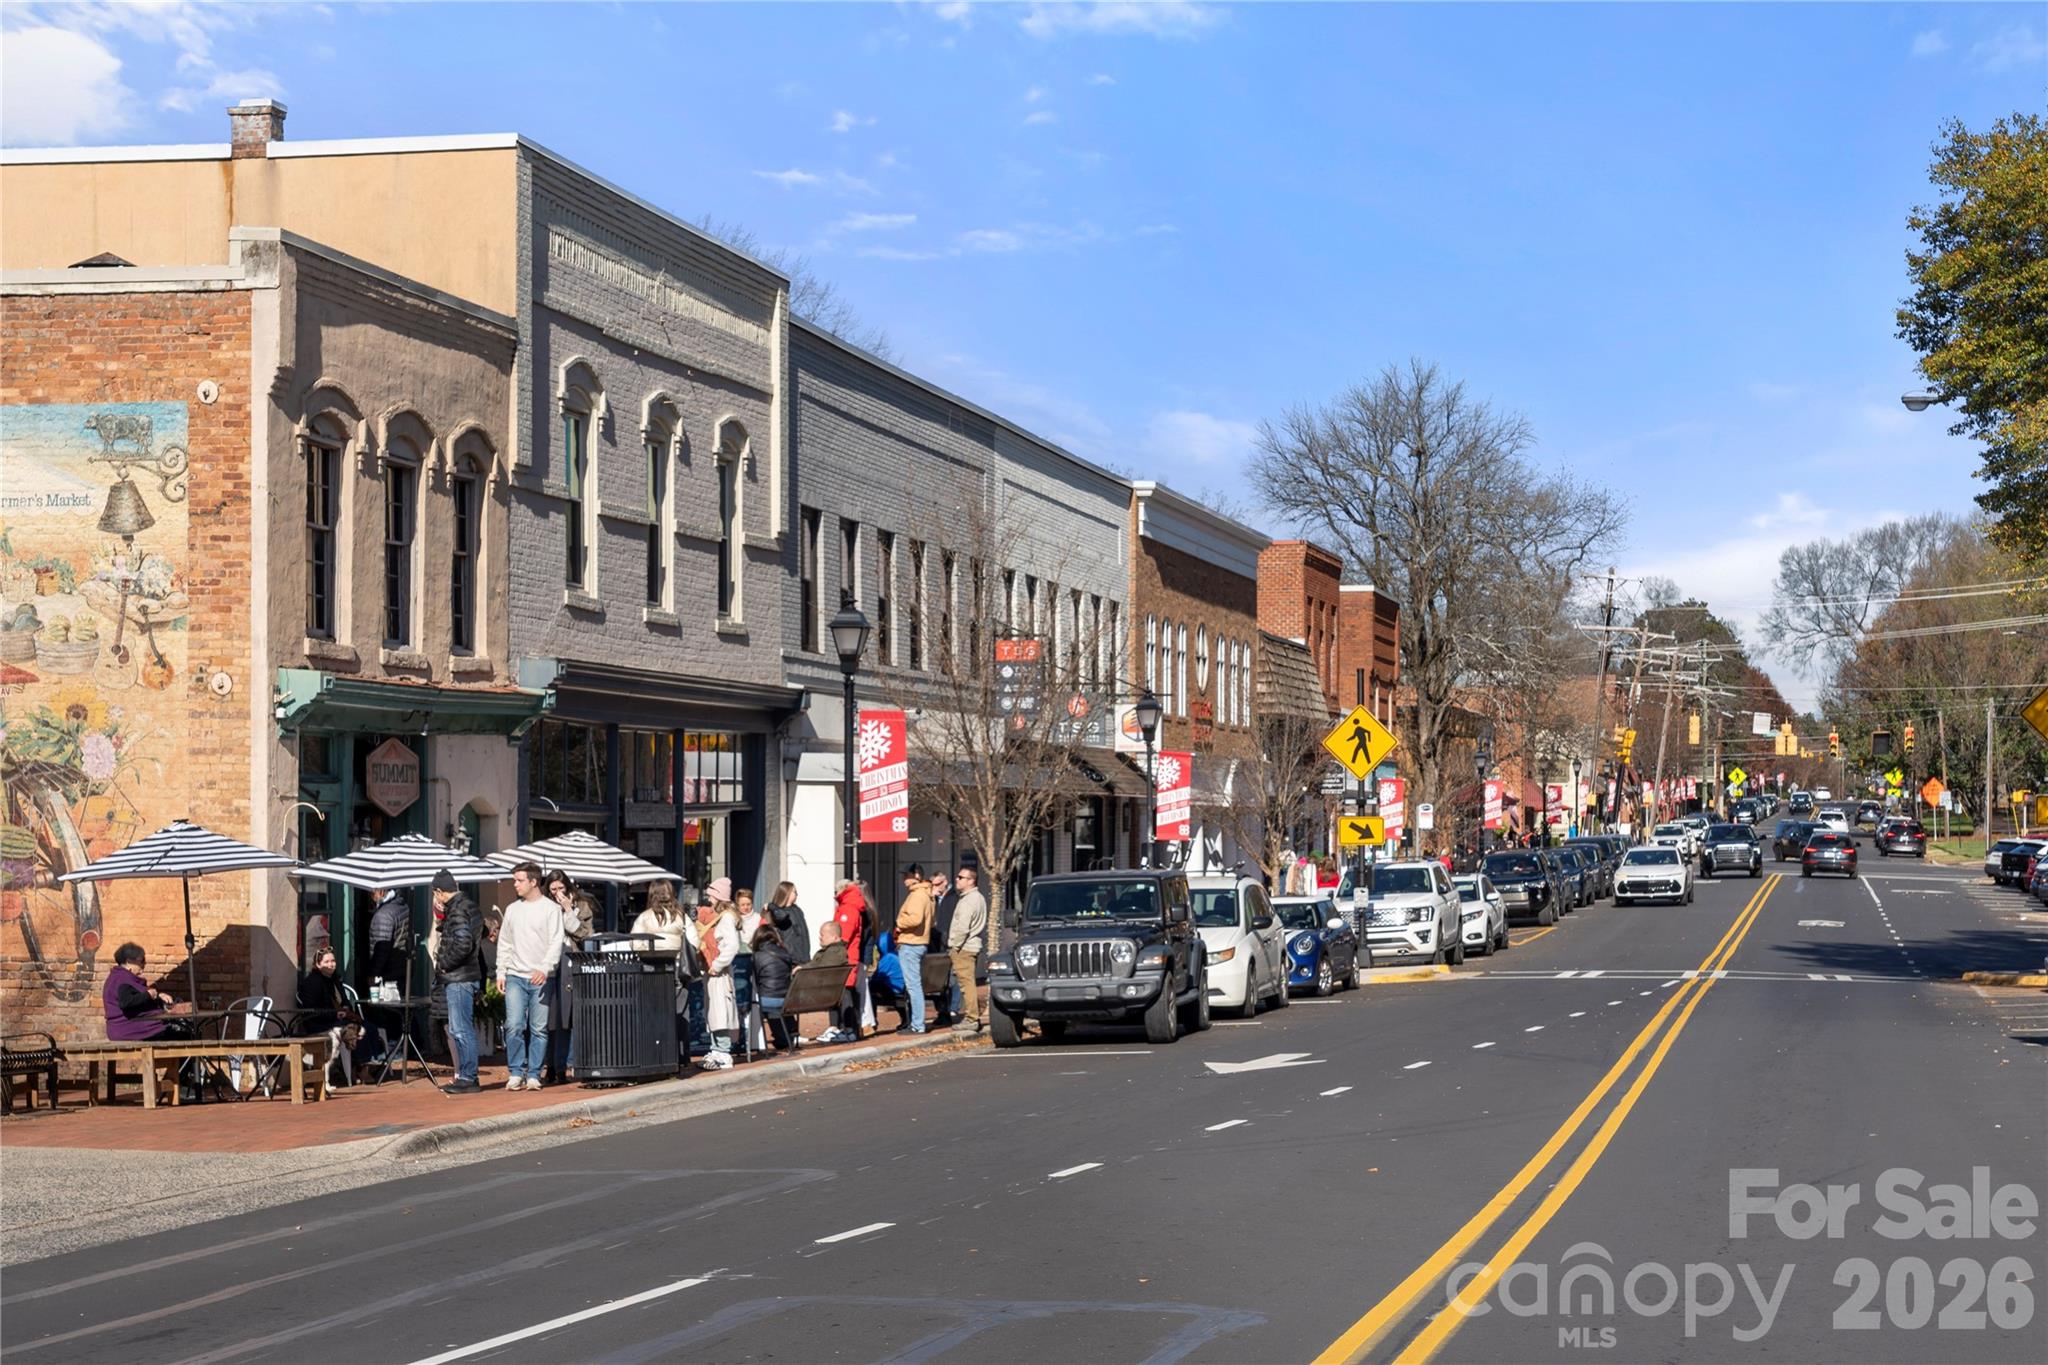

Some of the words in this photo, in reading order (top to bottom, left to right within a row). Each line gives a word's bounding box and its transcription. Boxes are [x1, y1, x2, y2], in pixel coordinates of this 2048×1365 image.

[46, 493, 91, 507] Market
[371, 763, 416, 784] SUMMIT
[581, 965, 606, 974] TRASH
